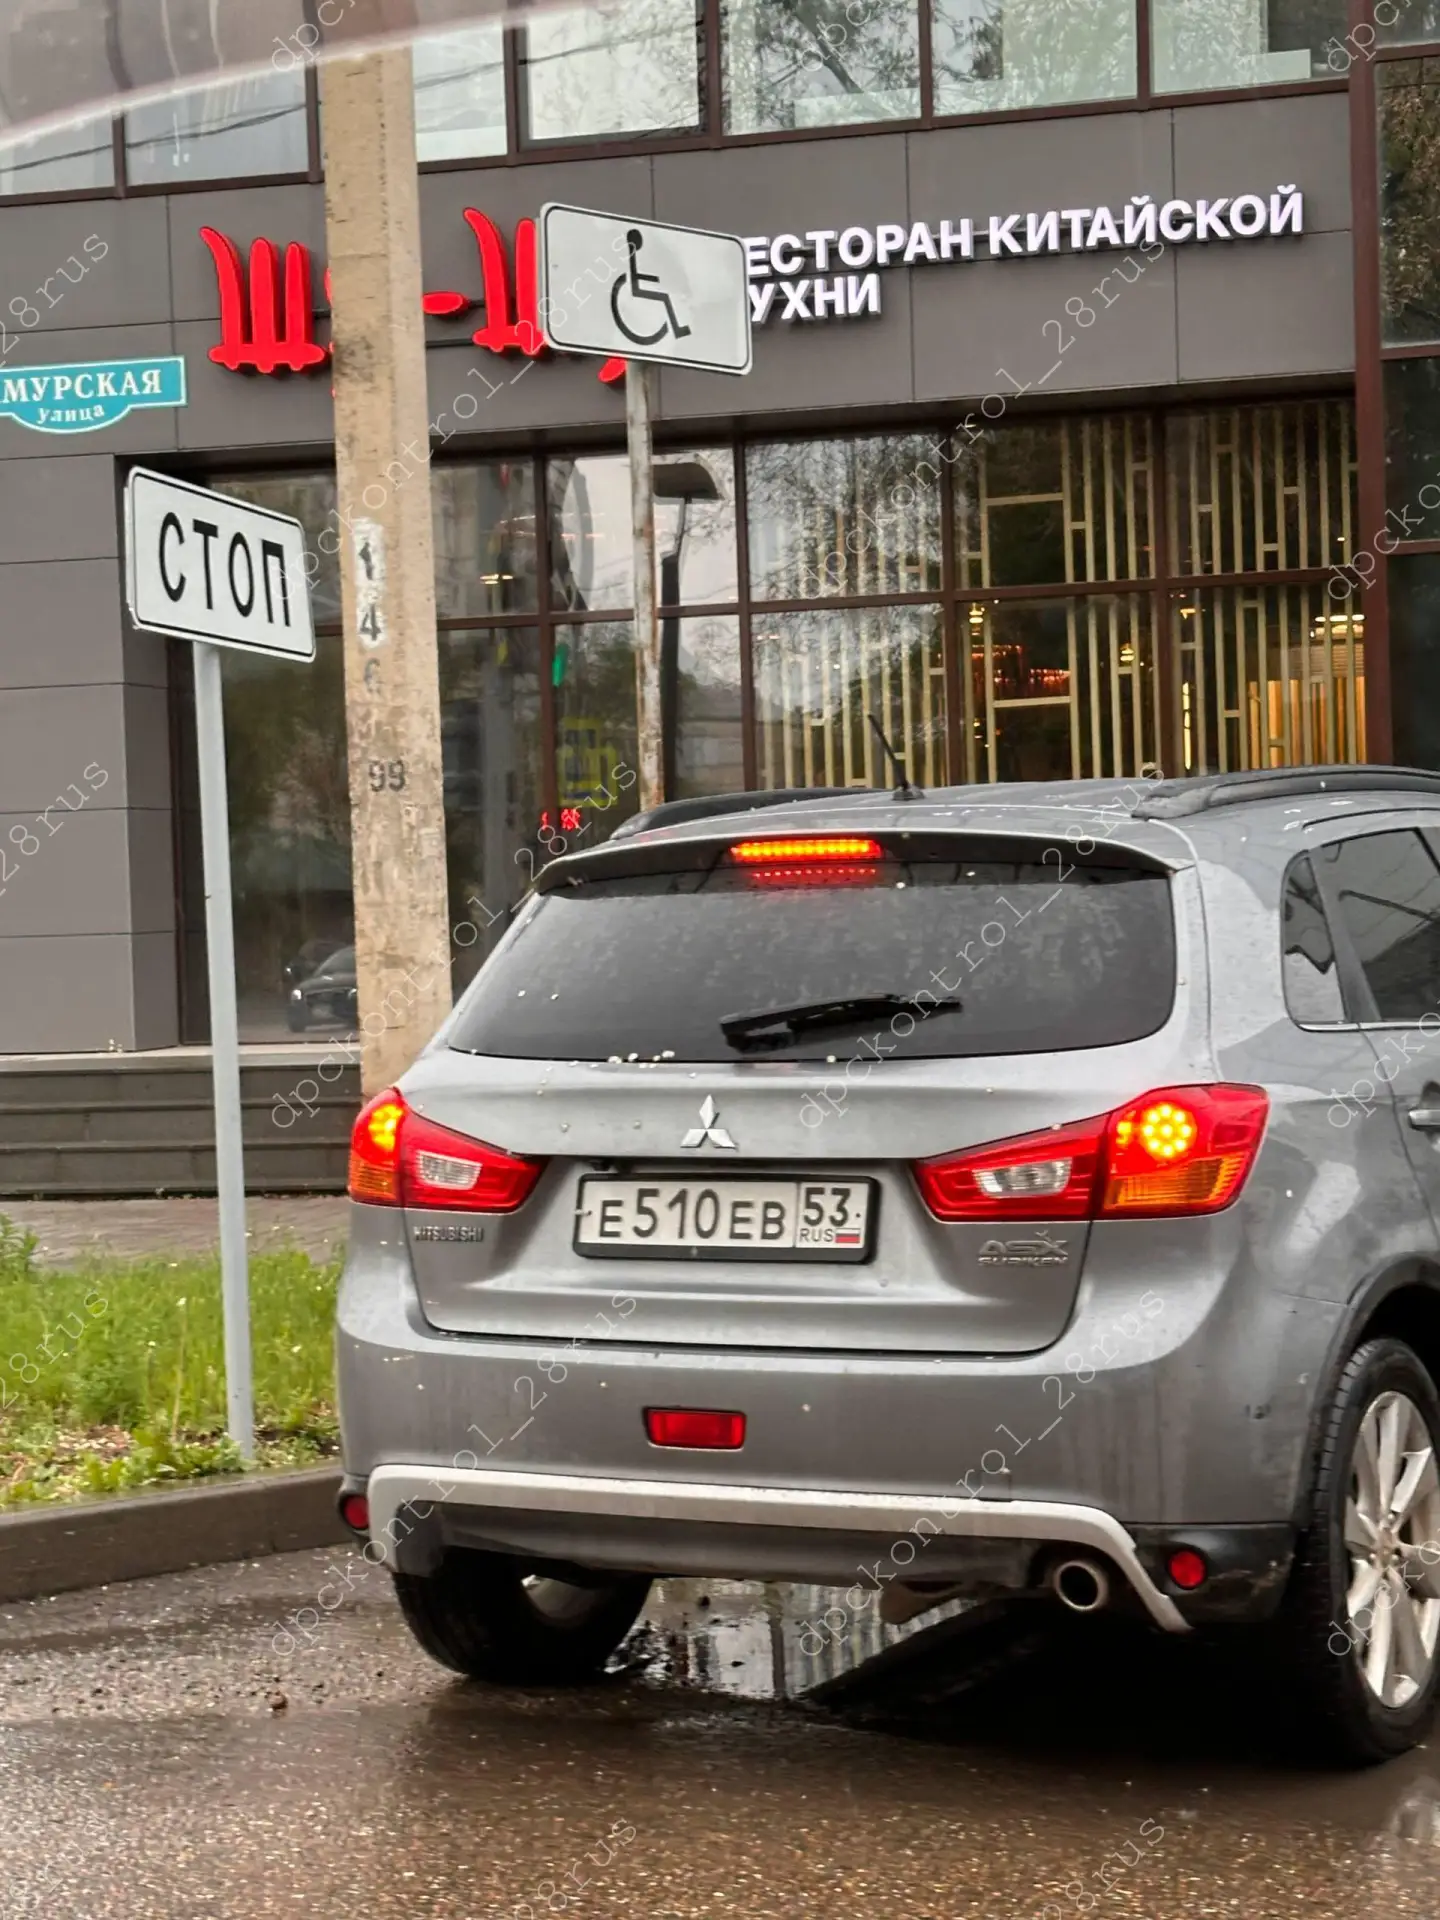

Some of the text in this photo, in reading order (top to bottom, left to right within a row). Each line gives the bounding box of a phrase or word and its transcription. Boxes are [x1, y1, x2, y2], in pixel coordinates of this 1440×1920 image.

[748, 184, 1304, 276] ЕСТОРАН КИТАЙСКОЙ
[749, 273, 881, 324] УХНИ
[1, 369, 162, 404] МУРСКАЯ
[37, 404, 105, 425] улица
[159, 511, 291, 627] СТОП
[368, 759, 406, 792] 99
[803, 1187, 851, 1227] 53
[800, 1228, 834, 1243] RUS
